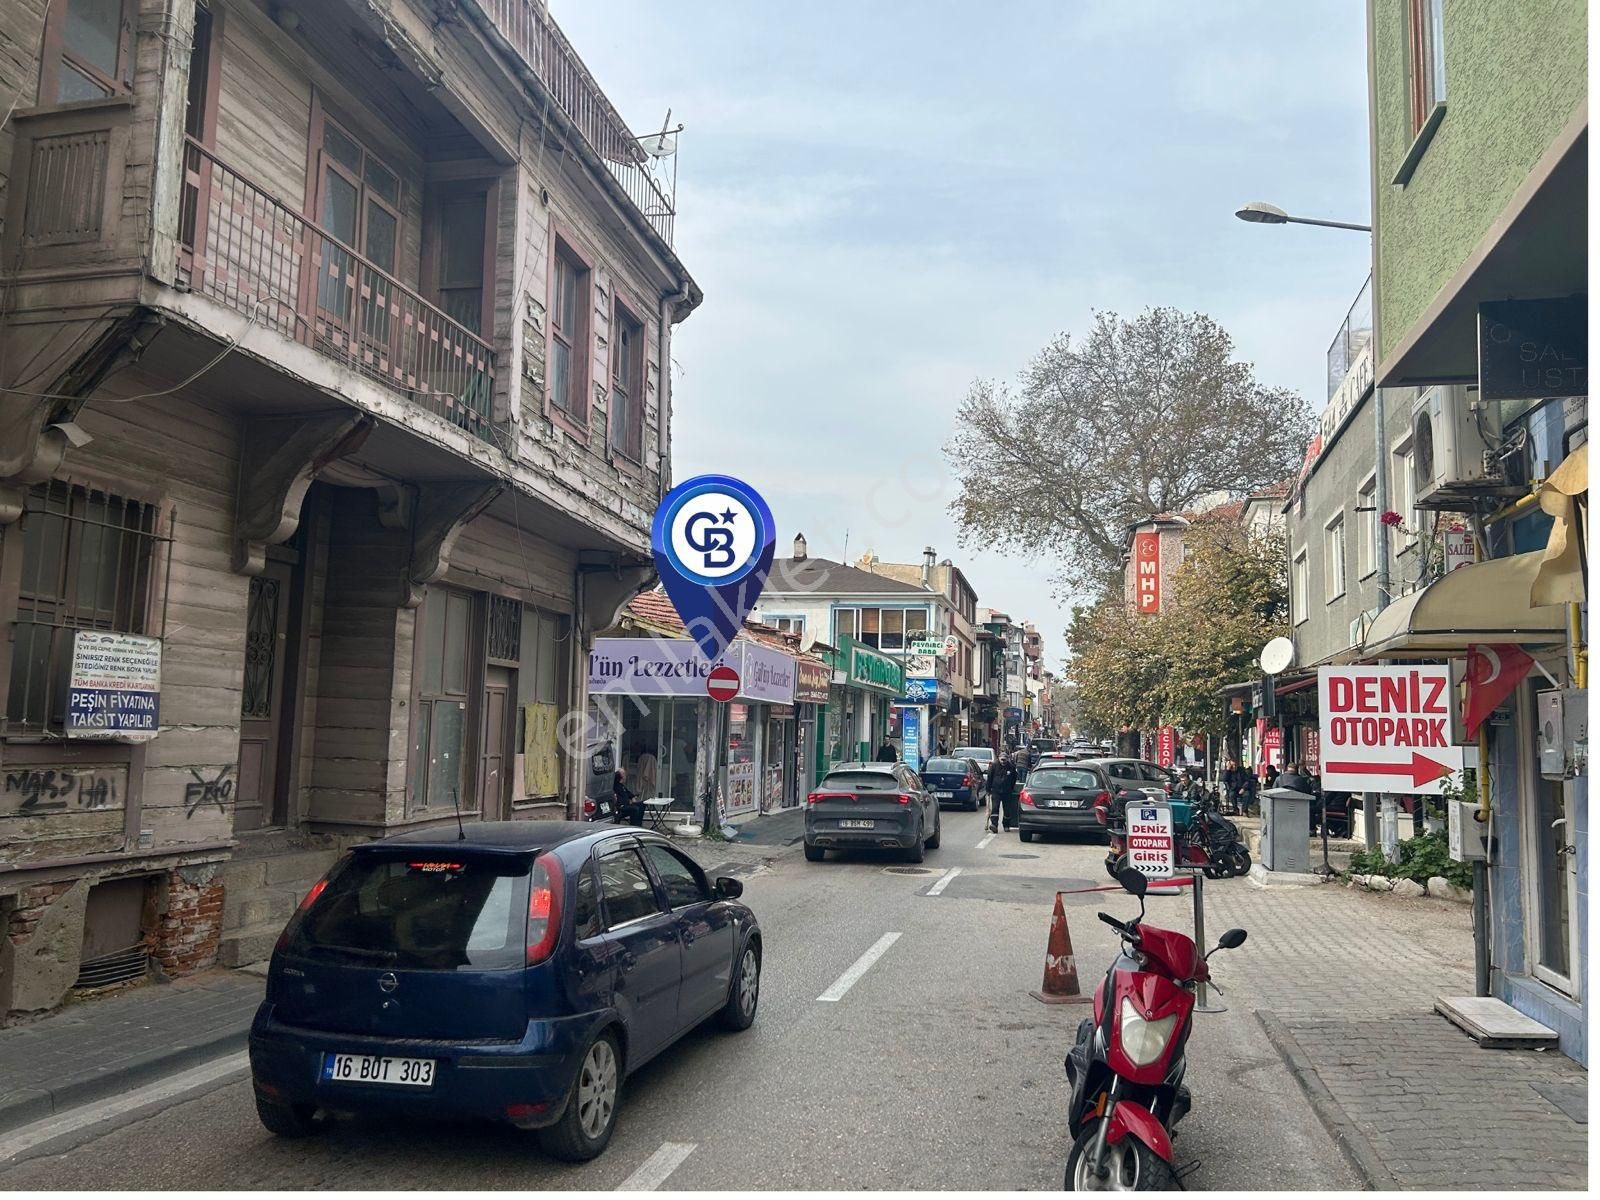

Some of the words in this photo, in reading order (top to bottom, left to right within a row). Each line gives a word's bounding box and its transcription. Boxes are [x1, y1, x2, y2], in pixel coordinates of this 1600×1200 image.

[1140, 561, 1156, 608] MHP
[104, 655, 120, 663] RENK
[110, 664, 126, 672] RENK
[74, 677, 88, 686] TÜM
[89, 679, 108, 688] BANKA
[109, 679, 126, 688] KREDİ
[1328, 670, 1448, 714] DENİZ
[71, 690, 107, 712] PEŞİN
[110, 692, 155, 710] FİYATINA
[71, 710, 116, 727] TAKSİT
[118, 713, 153, 728] YAPILIR
[1330, 717, 1449, 748] OTOPARK
[1132, 824, 1168, 834] DENİZ
[1132, 838, 1169, 848] OTOPARK
[1134, 851, 1168, 864] GİRİŞ
[336, 1056, 353, 1078] 16
[400, 1060, 432, 1083] 303
